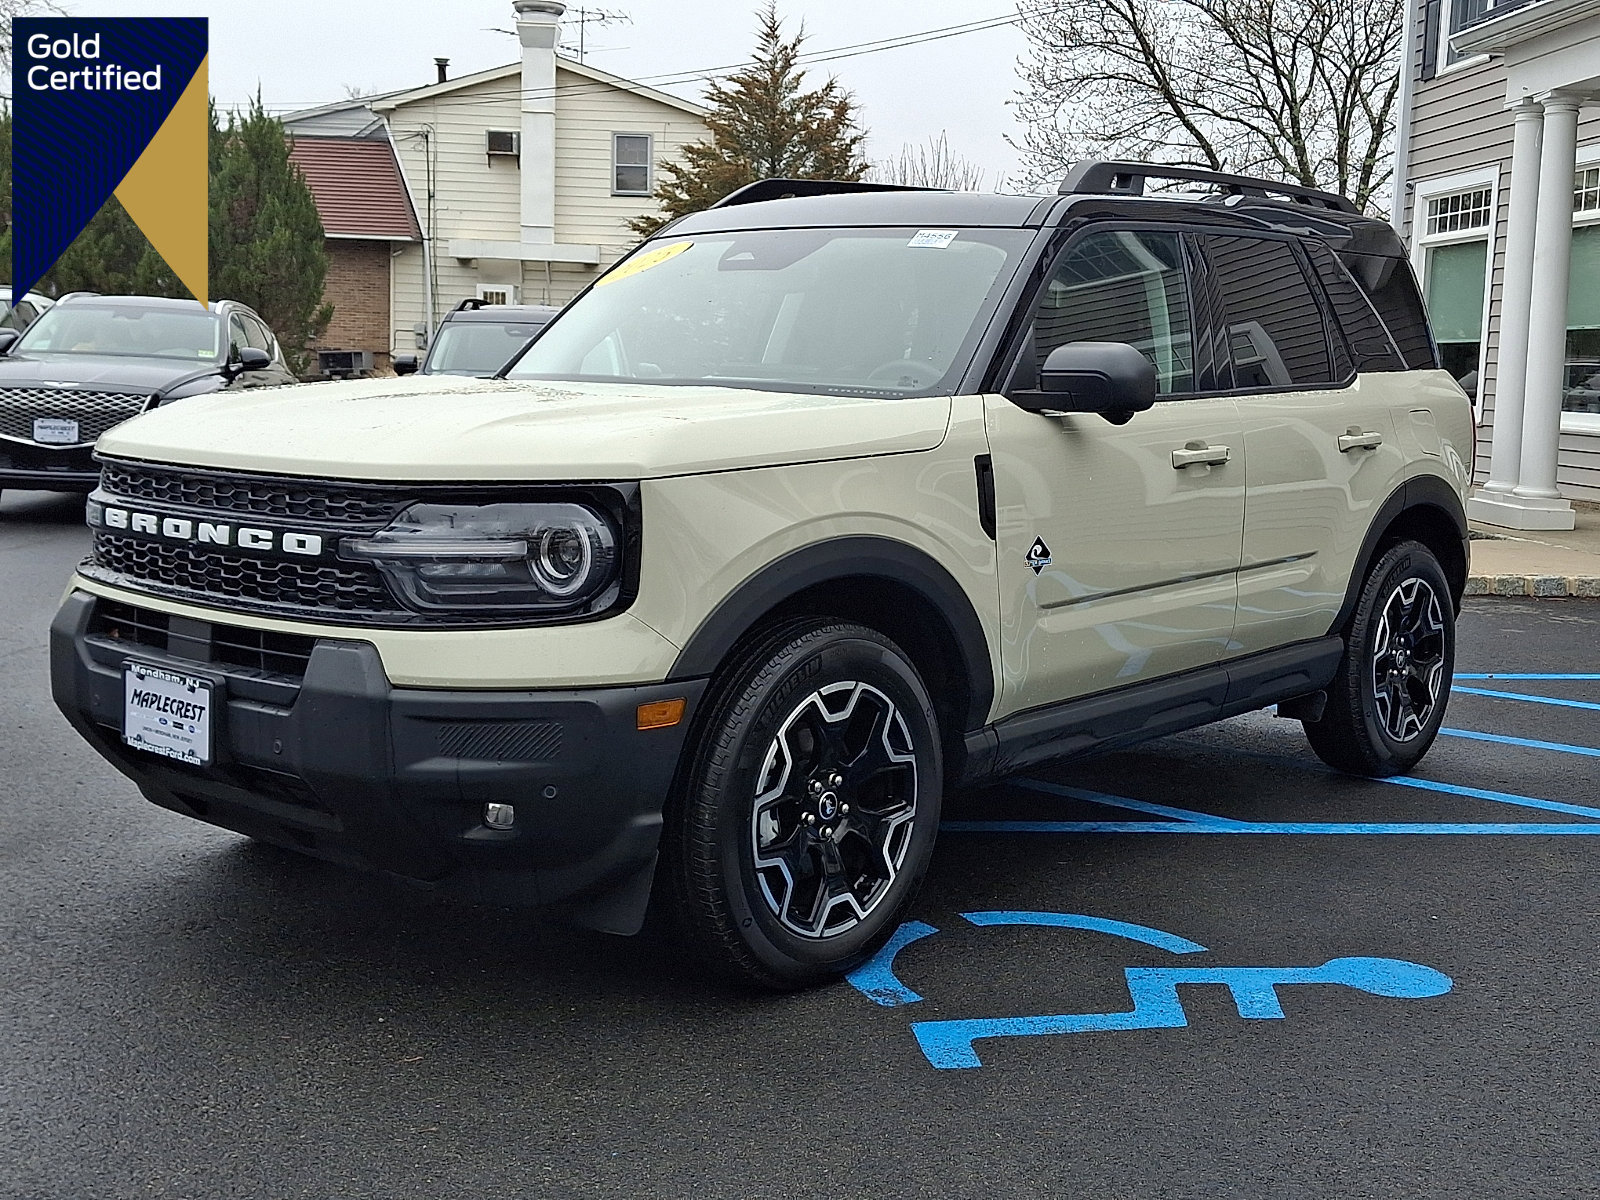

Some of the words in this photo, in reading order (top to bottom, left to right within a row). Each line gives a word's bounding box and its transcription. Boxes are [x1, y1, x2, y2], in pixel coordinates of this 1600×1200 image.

[105, 507, 322, 556] BRONCO
[186, 677, 200, 688] NJ
[130, 688, 206, 723] MAPLECREST
